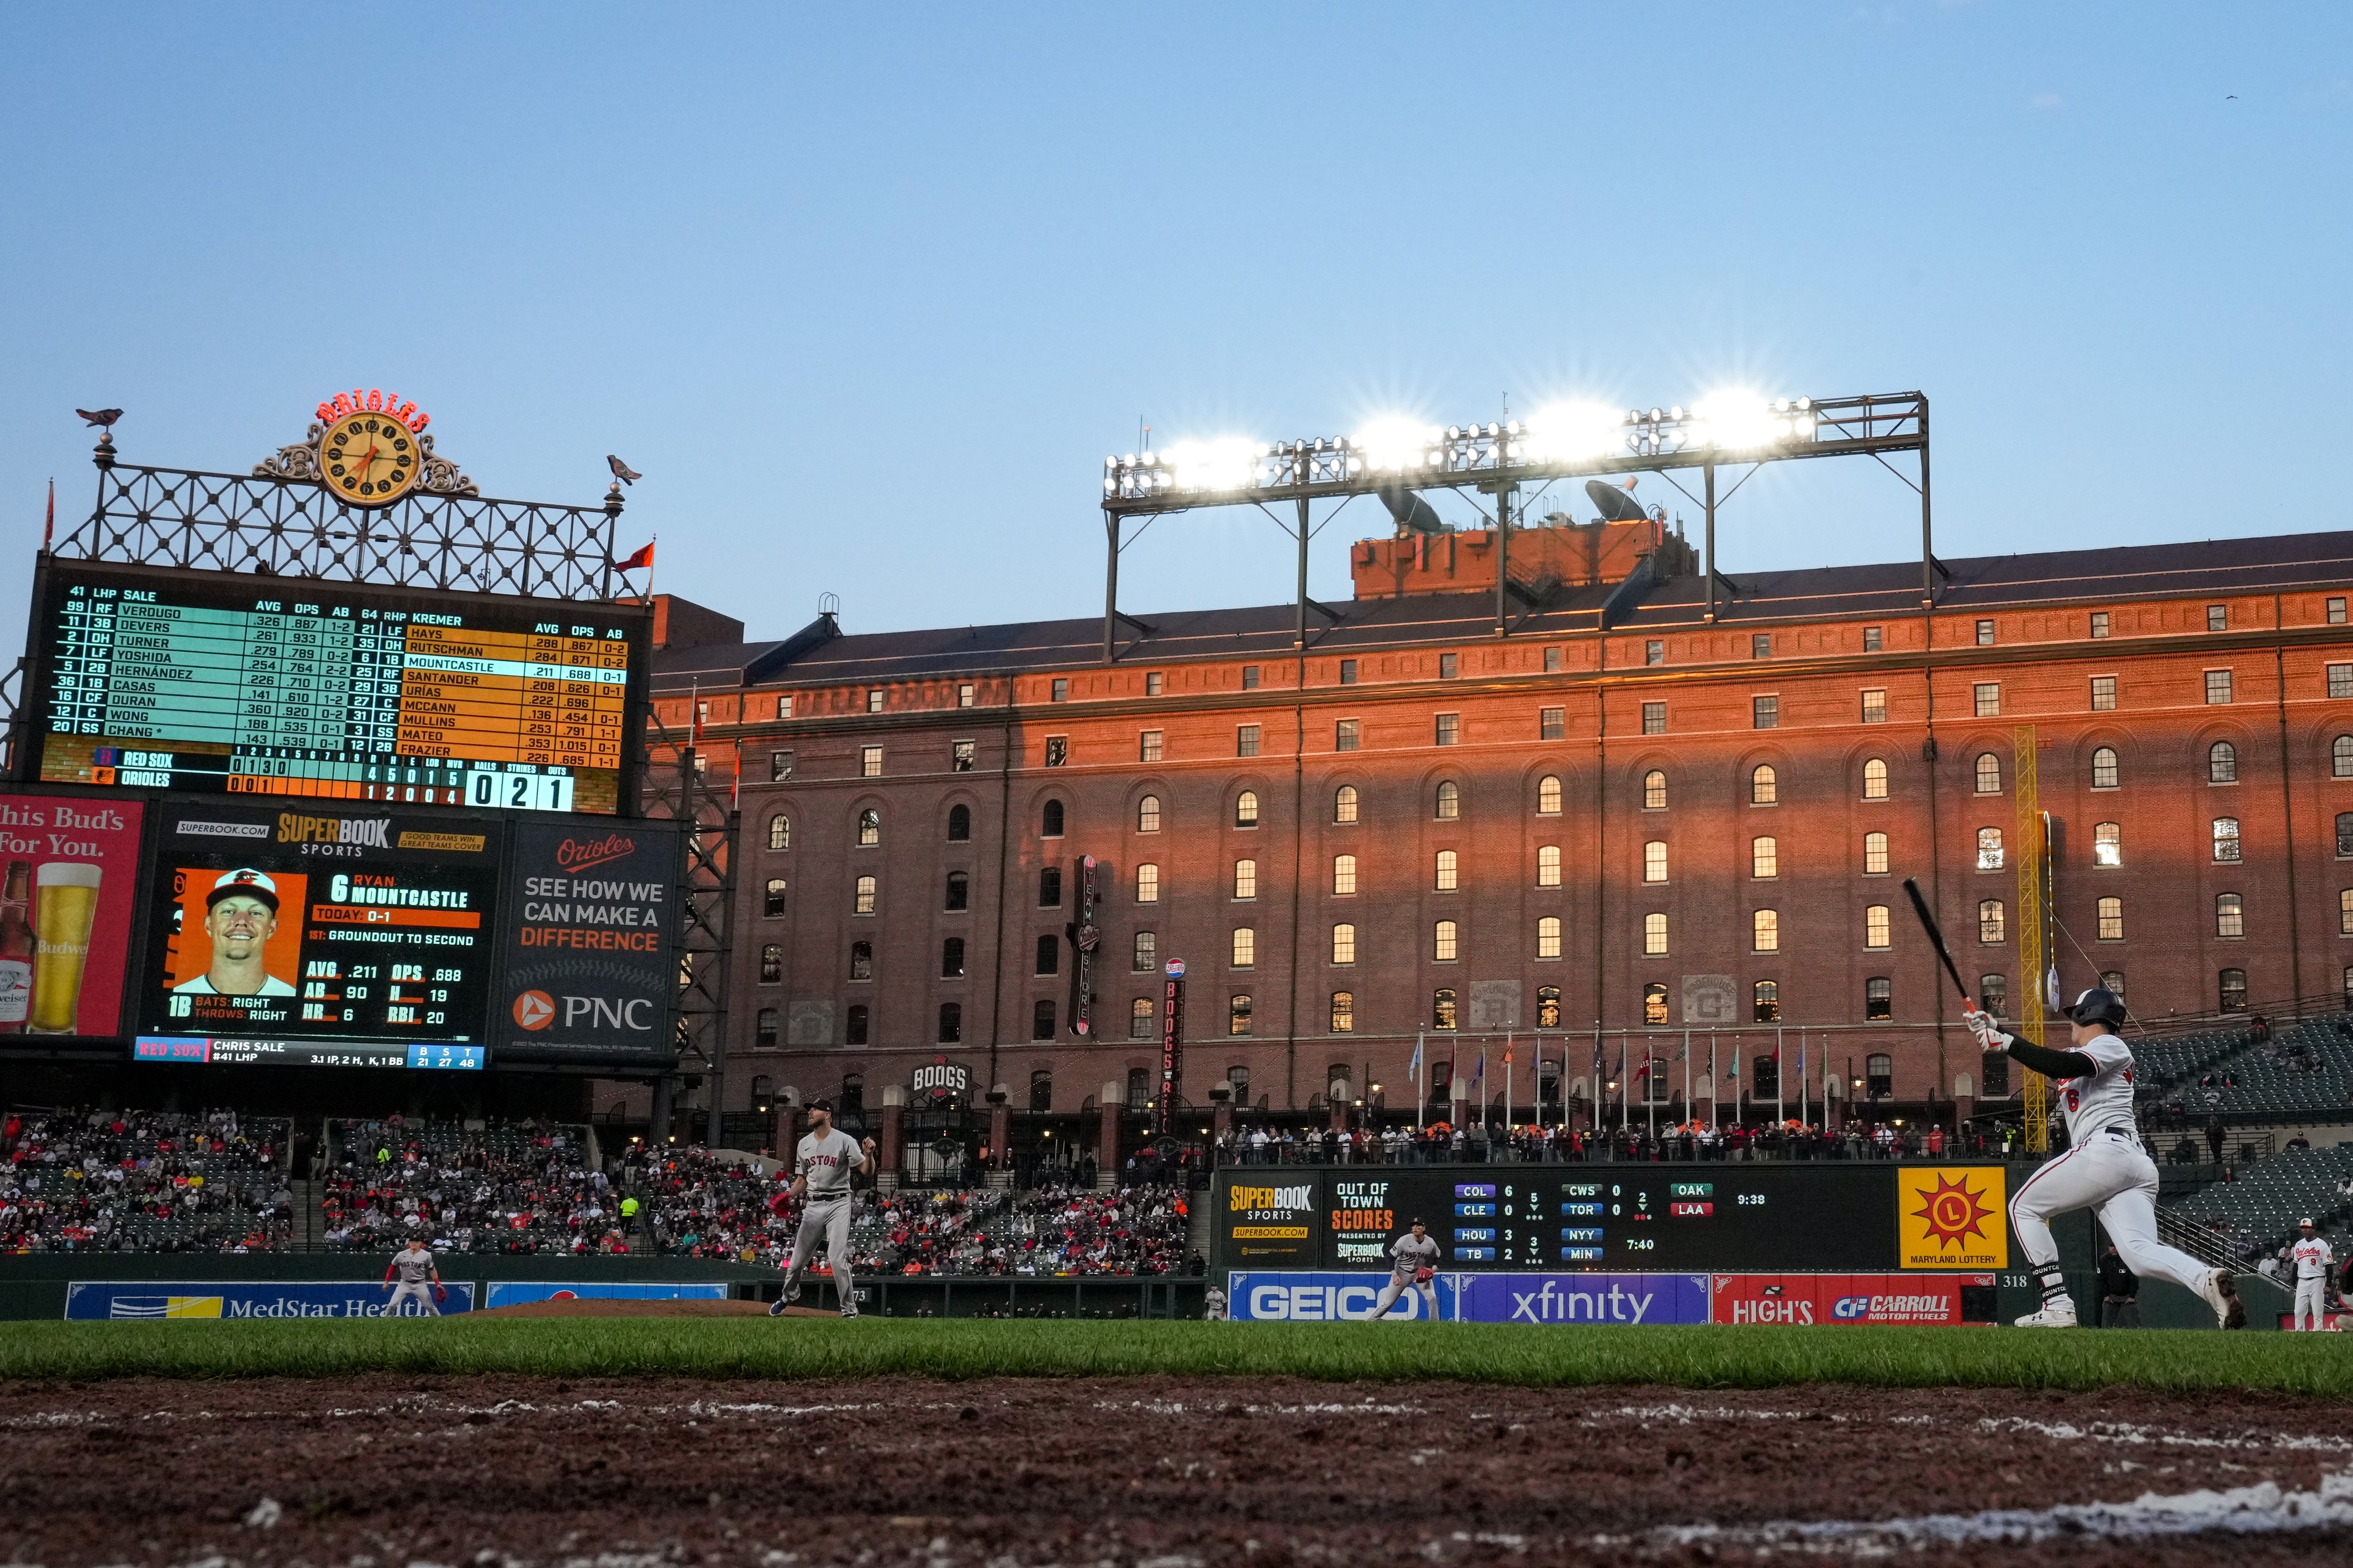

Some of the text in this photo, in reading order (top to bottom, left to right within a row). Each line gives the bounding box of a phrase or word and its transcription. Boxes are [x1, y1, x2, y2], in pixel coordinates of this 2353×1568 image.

[315, 389, 430, 431] ORIOLES
[70, 587, 156, 601] 41 LHP SALE
[122, 606, 181, 619] VERDUGO
[256, 600, 349, 617] AVG OPS AB
[362, 609, 461, 626] 64 RHP KREMER
[121, 620, 170, 633] DEVERS
[535, 623, 623, 640] AVG OPS AB
[412, 628, 442, 639] HAYS
[119, 635, 169, 648] TURNER
[410, 642, 483, 657] RUTSCHMAN
[118, 650, 171, 663] YOSHIDA
[409, 657, 494, 672] MOUNTCASTLE
[116, 664, 192, 679] HERNÁNDEZ
[407, 672, 478, 685] SANTANDER
[114, 680, 155, 692] CASAS
[406, 685, 441, 697] URÍAS
[112, 695, 156, 707] DURAN
[406, 701, 456, 713] MCCANN
[110, 710, 148, 722] WONG
[404, 715, 455, 727] MULLINS
[108, 725, 152, 737] CHANG
[403, 730, 443, 741] MATEO
[401, 744, 450, 757] FRAZIER
[124, 751, 173, 768] RED SOX
[475, 760, 566, 775] BALLS STRIKES OUTS
[122, 772, 170, 787] ORIOLES
[476, 774, 561, 809] 0 2 1
[0, 805, 44, 826] his
[180, 823, 266, 835] SUPERBOOK.COM
[277, 813, 390, 848] SUPERBOOK
[0, 832, 104, 857] For You.
[301, 844, 362, 857] SPORTS
[557, 834, 635, 873] Orioles
[354, 875, 394, 886] RYAN
[331, 874, 349, 902] 6
[525, 877, 664, 902] SEE HOW WE
[351, 887, 468, 908] MOUNTCASTLE
[318, 908, 363, 920] TODAY:
[525, 902, 658, 927] CAN MAKE A
[329, 930, 403, 943] GROUNDOUT
[407, 933, 422, 943] TO
[425, 935, 473, 946] SECOND
[521, 927, 659, 952] DIFFERENCE
[307, 961, 377, 978] AVG .211
[392, 964, 461, 981] OPS .688
[304, 982, 367, 999] AB 90
[389, 985, 447, 1002] H 19
[170, 996, 191, 1017] 1B
[196, 996, 270, 1008] BATS: RIGHT
[195, 1009, 287, 1021] THROWS: RIGHT
[303, 1004, 353, 1021] HR 6
[388, 1006, 444, 1023] RBI 20
[562, 996, 652, 1030] PNC
[139, 1043, 202, 1057] RED SOX
[214, 1041, 285, 1052] CHRIS SALE
[328, 1055, 339, 1065] IP,
[353, 1057, 362, 1066] H,
[369, 1057, 379, 1066] K,
[2067, 1089, 2079, 1112] 6
[806, 1155, 837, 1168] OSTON
[1337, 1183, 1388, 1195] OUT OF
[1464, 1186, 1487, 1197] COL
[1569, 1186, 1595, 1196] CWS
[1678, 1185, 1704, 1195] OAK
[1230, 1185, 1312, 1211] SUPERBOOK
[1341, 1196, 1383, 1208] TOWN
[1738, 1194, 1765, 1205] 9:38
[1247, 1211, 1291, 1220] SPORTS
[1464, 1205, 1486, 1216] CLE
[1570, 1205, 1594, 1215] TOR
[1678, 1205, 1703, 1215] LAA
[1332, 1210, 1393, 1229] SCORES
[1462, 1231, 1487, 1240] HOU
[1570, 1230, 1594, 1240] NYY
[1338, 1243, 1384, 1258] SUPERBOOK
[1627, 1239, 1654, 1250] 7:40
[1466, 1249, 1482, 1259] TB
[1571, 1249, 1593, 1259] MIN
[2003, 1276, 2027, 1287] 318
[228, 1298, 338, 1317] MedStar
[1250, 1286, 1418, 1321] GEICO
[1512, 1281, 1654, 1324] xfinity
[1870, 1295, 1950, 1312] CARROLL
[1733, 1300, 1813, 1325] HIGH'S
